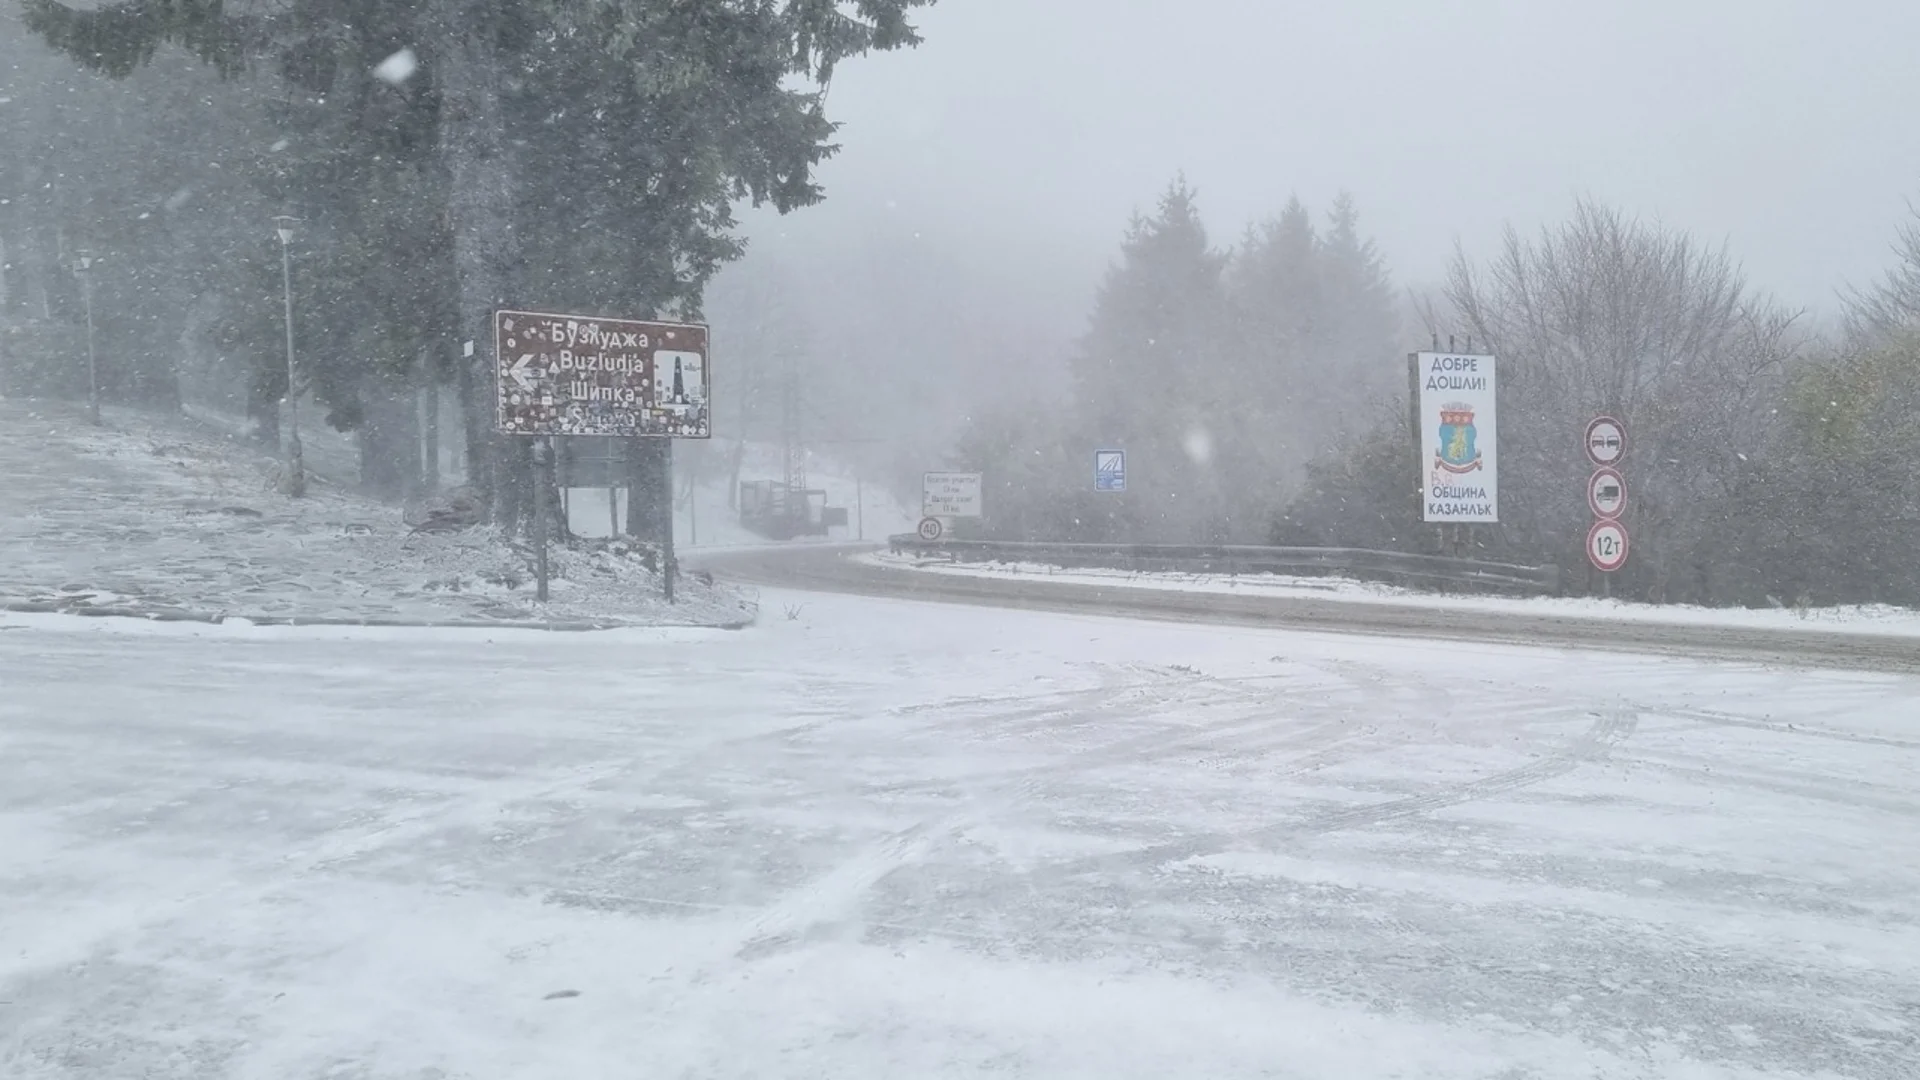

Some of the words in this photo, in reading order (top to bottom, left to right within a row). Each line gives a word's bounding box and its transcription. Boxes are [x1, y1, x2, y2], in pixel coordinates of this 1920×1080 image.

[560, 350, 644, 376] Buzludja
[1431, 357, 1477, 372] ДОБРЕ
[1426, 375, 1486, 391] ДОШЛИ!
[571, 381, 634, 401] Шипка
[1432, 486, 1487, 499] ОБЩИНА
[1428, 502, 1492, 515] КАЗАНЛЪК
[923, 523, 937, 536] 40
